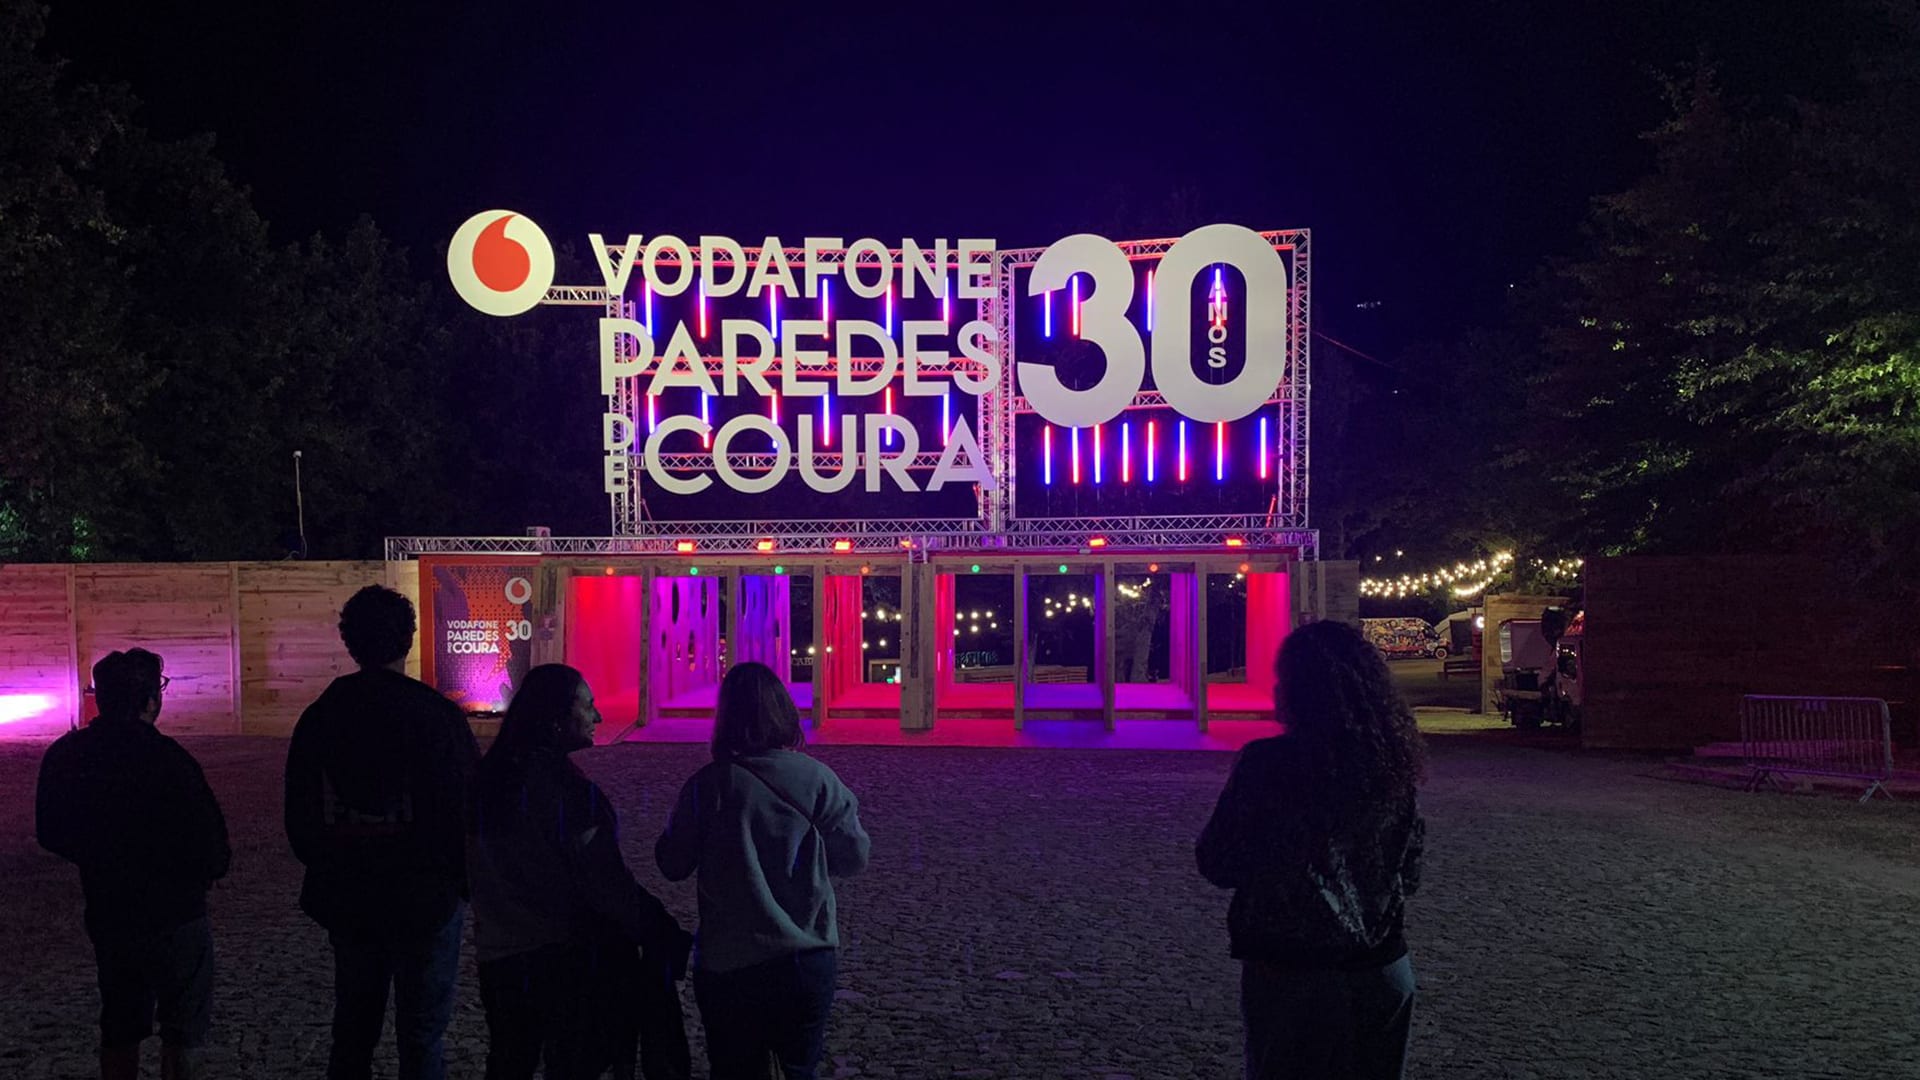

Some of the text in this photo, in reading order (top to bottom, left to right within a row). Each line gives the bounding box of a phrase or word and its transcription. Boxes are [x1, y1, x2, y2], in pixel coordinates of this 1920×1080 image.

[588, 233, 998, 299] VODAFONE
[1017, 223, 1287, 428] 30
[599, 317, 1002, 396] PAREDES
[603, 412, 999, 495] DE COURA
[447, 620, 499, 629] VODAFONE
[447, 630, 500, 641] PAREDES
[505, 619, 532, 641] 30
[452, 641, 500, 653] COURA
